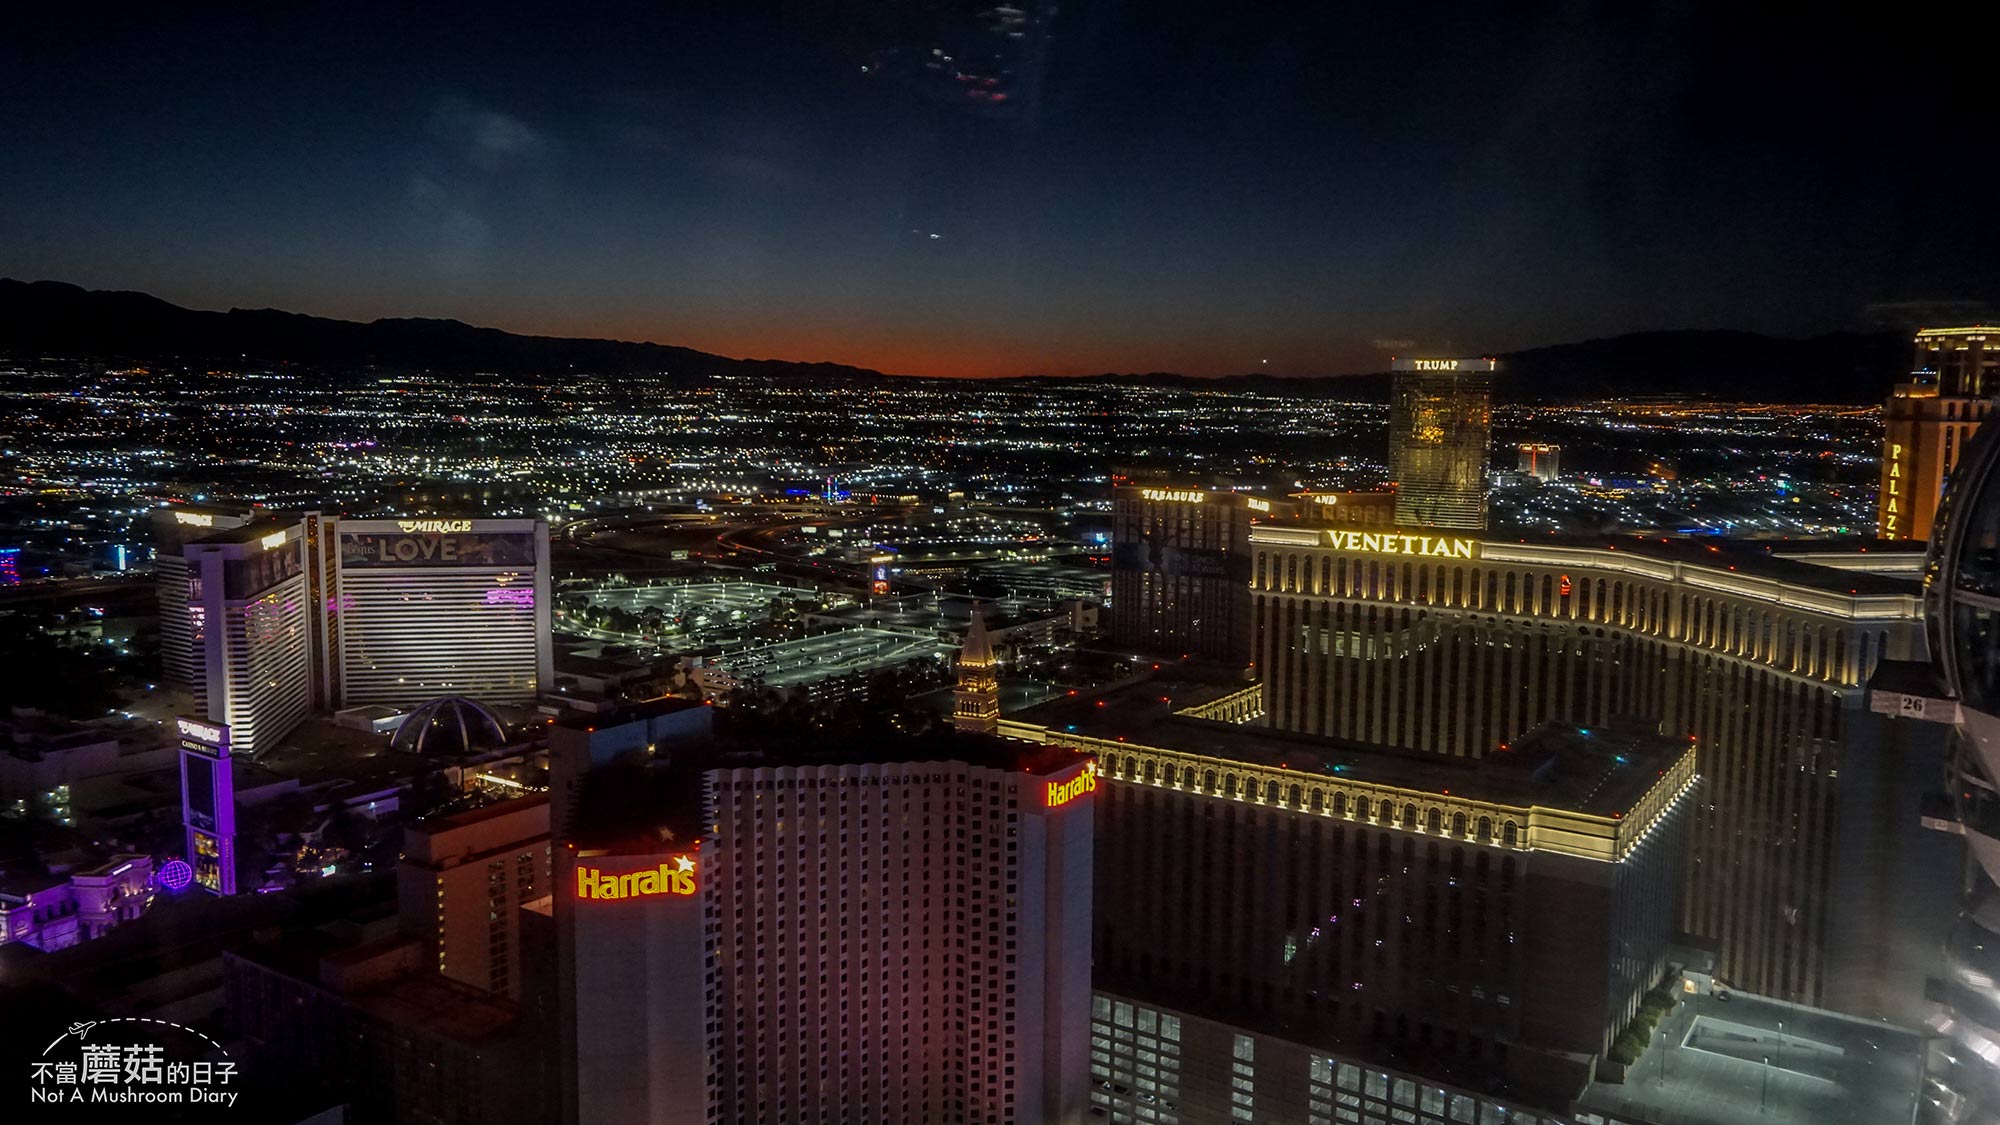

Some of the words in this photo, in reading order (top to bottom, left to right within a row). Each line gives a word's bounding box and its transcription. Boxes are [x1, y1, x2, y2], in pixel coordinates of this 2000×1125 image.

[1415, 360, 1458, 371] TRUMP
[1142, 489, 1204, 503] TREASURE
[403, 521, 472, 534] MIRAGE
[380, 538, 457, 562] LOVE
[1327, 530, 1474, 559] VENETIAN
[1903, 697, 1923, 712] 26
